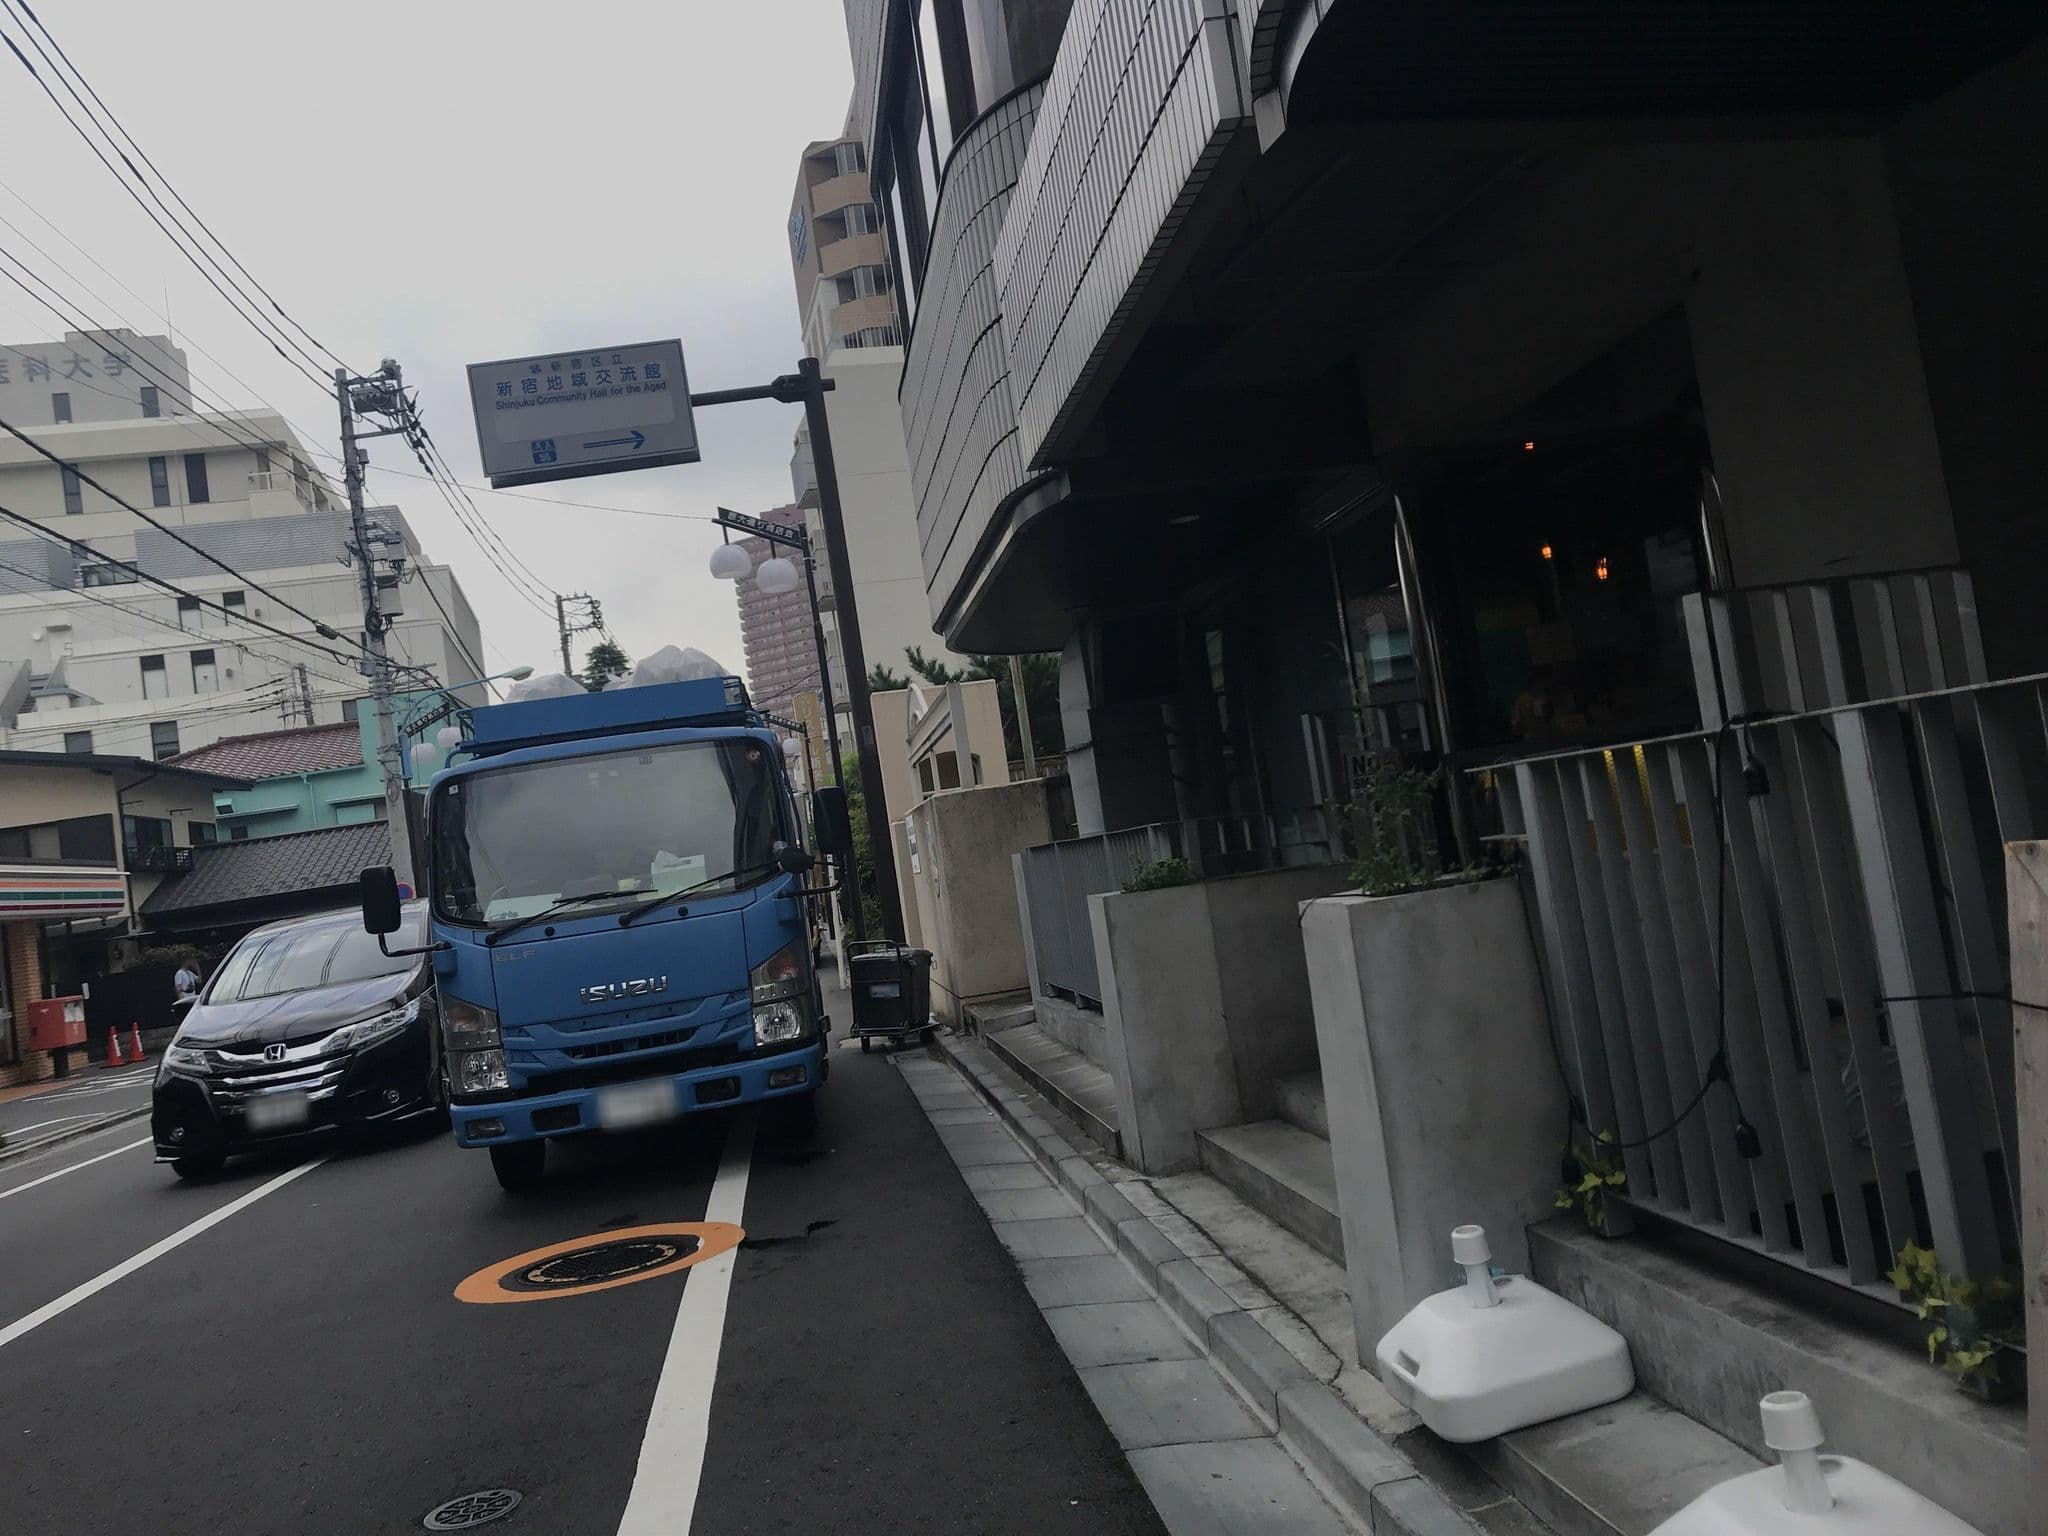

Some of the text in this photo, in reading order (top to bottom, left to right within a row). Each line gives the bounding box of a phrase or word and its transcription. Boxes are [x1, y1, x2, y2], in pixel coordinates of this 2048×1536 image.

[495, 363, 661, 397] 新宿地域交流館
[495, 380, 667, 411] Shinjuku Community Hall for the Aged
[580, 975, 667, 1003] ISUZU
